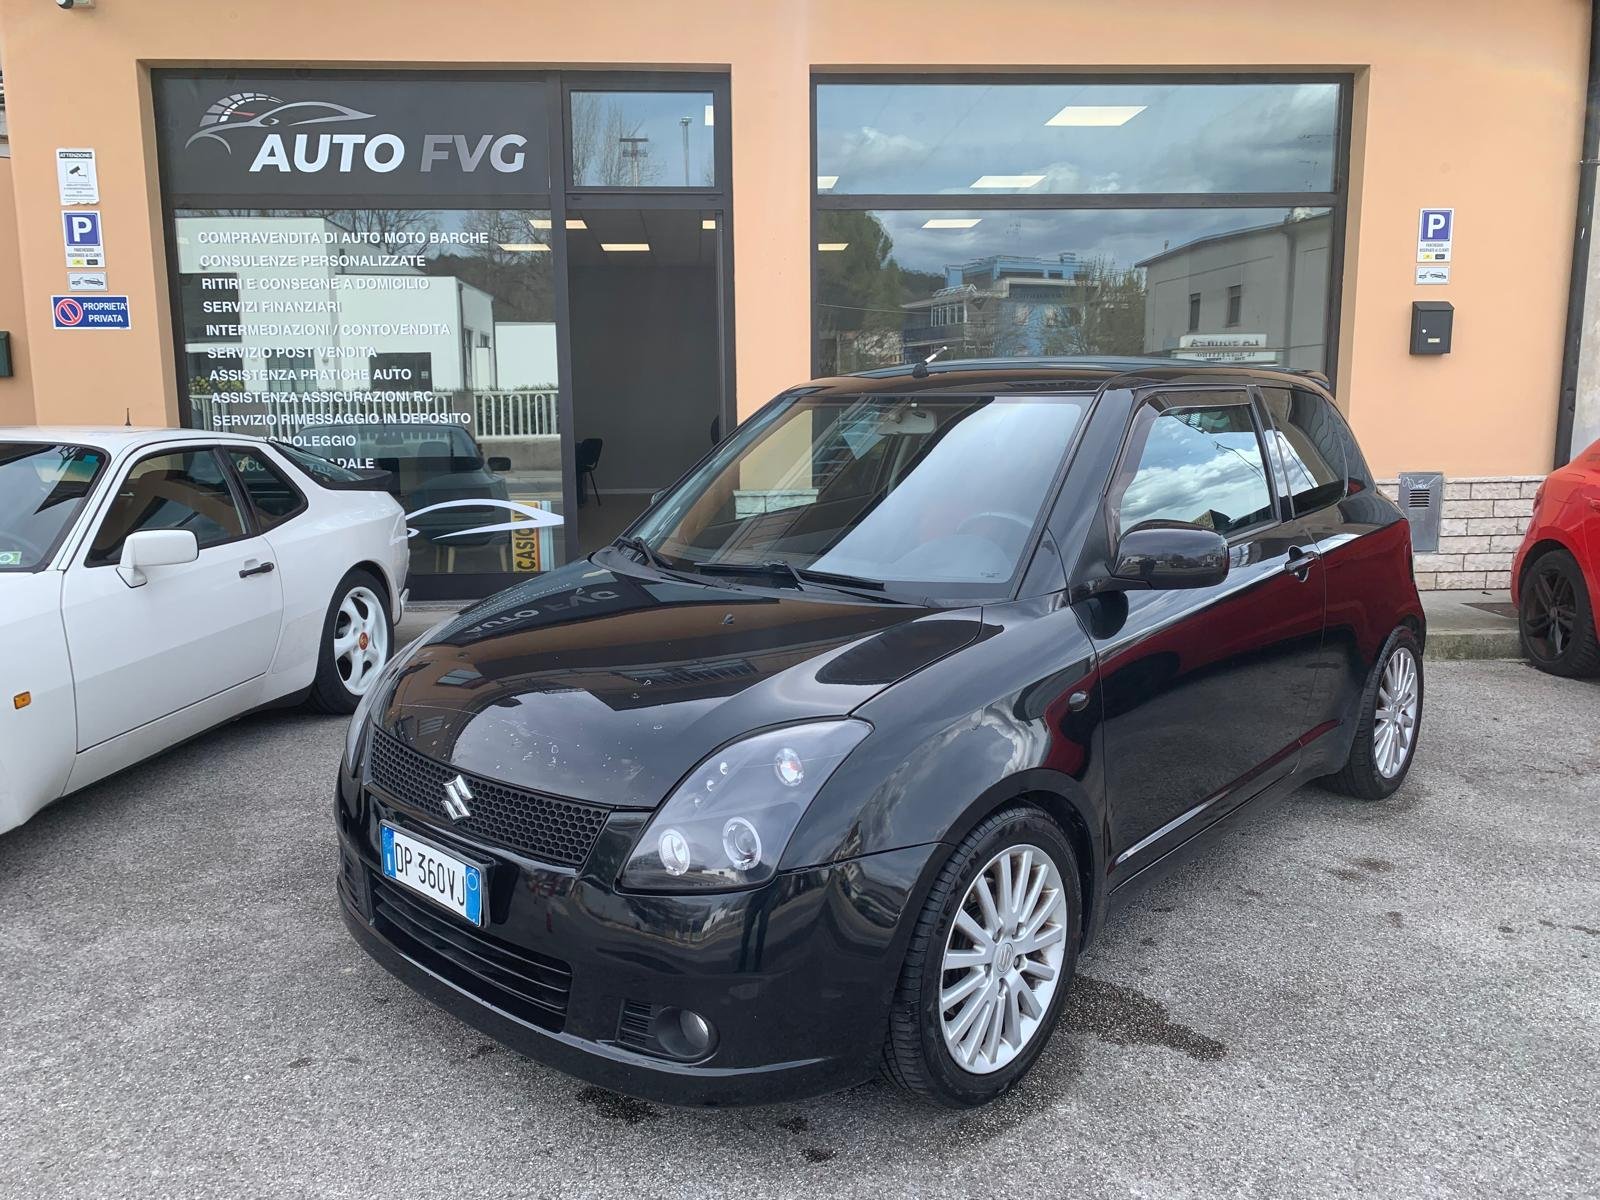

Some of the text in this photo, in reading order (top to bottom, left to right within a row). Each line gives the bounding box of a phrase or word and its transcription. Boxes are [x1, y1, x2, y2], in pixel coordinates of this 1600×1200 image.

[249, 134, 528, 173] AUTO FVG
[72, 216, 92, 242] P
[1427, 214, 1446, 238] P
[198, 232, 489, 244] COMPRAVENDITA DI AUTO MOTO BARCHE
[200, 255, 426, 267] CONSULENZE PERSONALIZZATE
[202, 278, 429, 290] RITIRI E CONSEGNE A DOMICILIO
[203, 301, 341, 313] SERVIZI FINANZIARI
[88, 314, 123, 323] PRIVATA
[206, 324, 330, 336] INTERMEDIAZIONI
[341, 323, 451, 335] CONTOVENDITA
[207, 346, 378, 359] SERVIZIO POST VENDITA
[209, 368, 412, 381] ASSISTENZA PRATICHE AUTO
[211, 391, 434, 403] ASSISTENZA ASSICURAZIONI RC
[213, 412, 471, 426] SERVIZIO RIMESSAGGIO IN DEPOSITO
[282, 435, 356, 447] NOLEGGIO
[395, 842, 412, 877] DP
[418, 852, 465, 906] 360VJ
